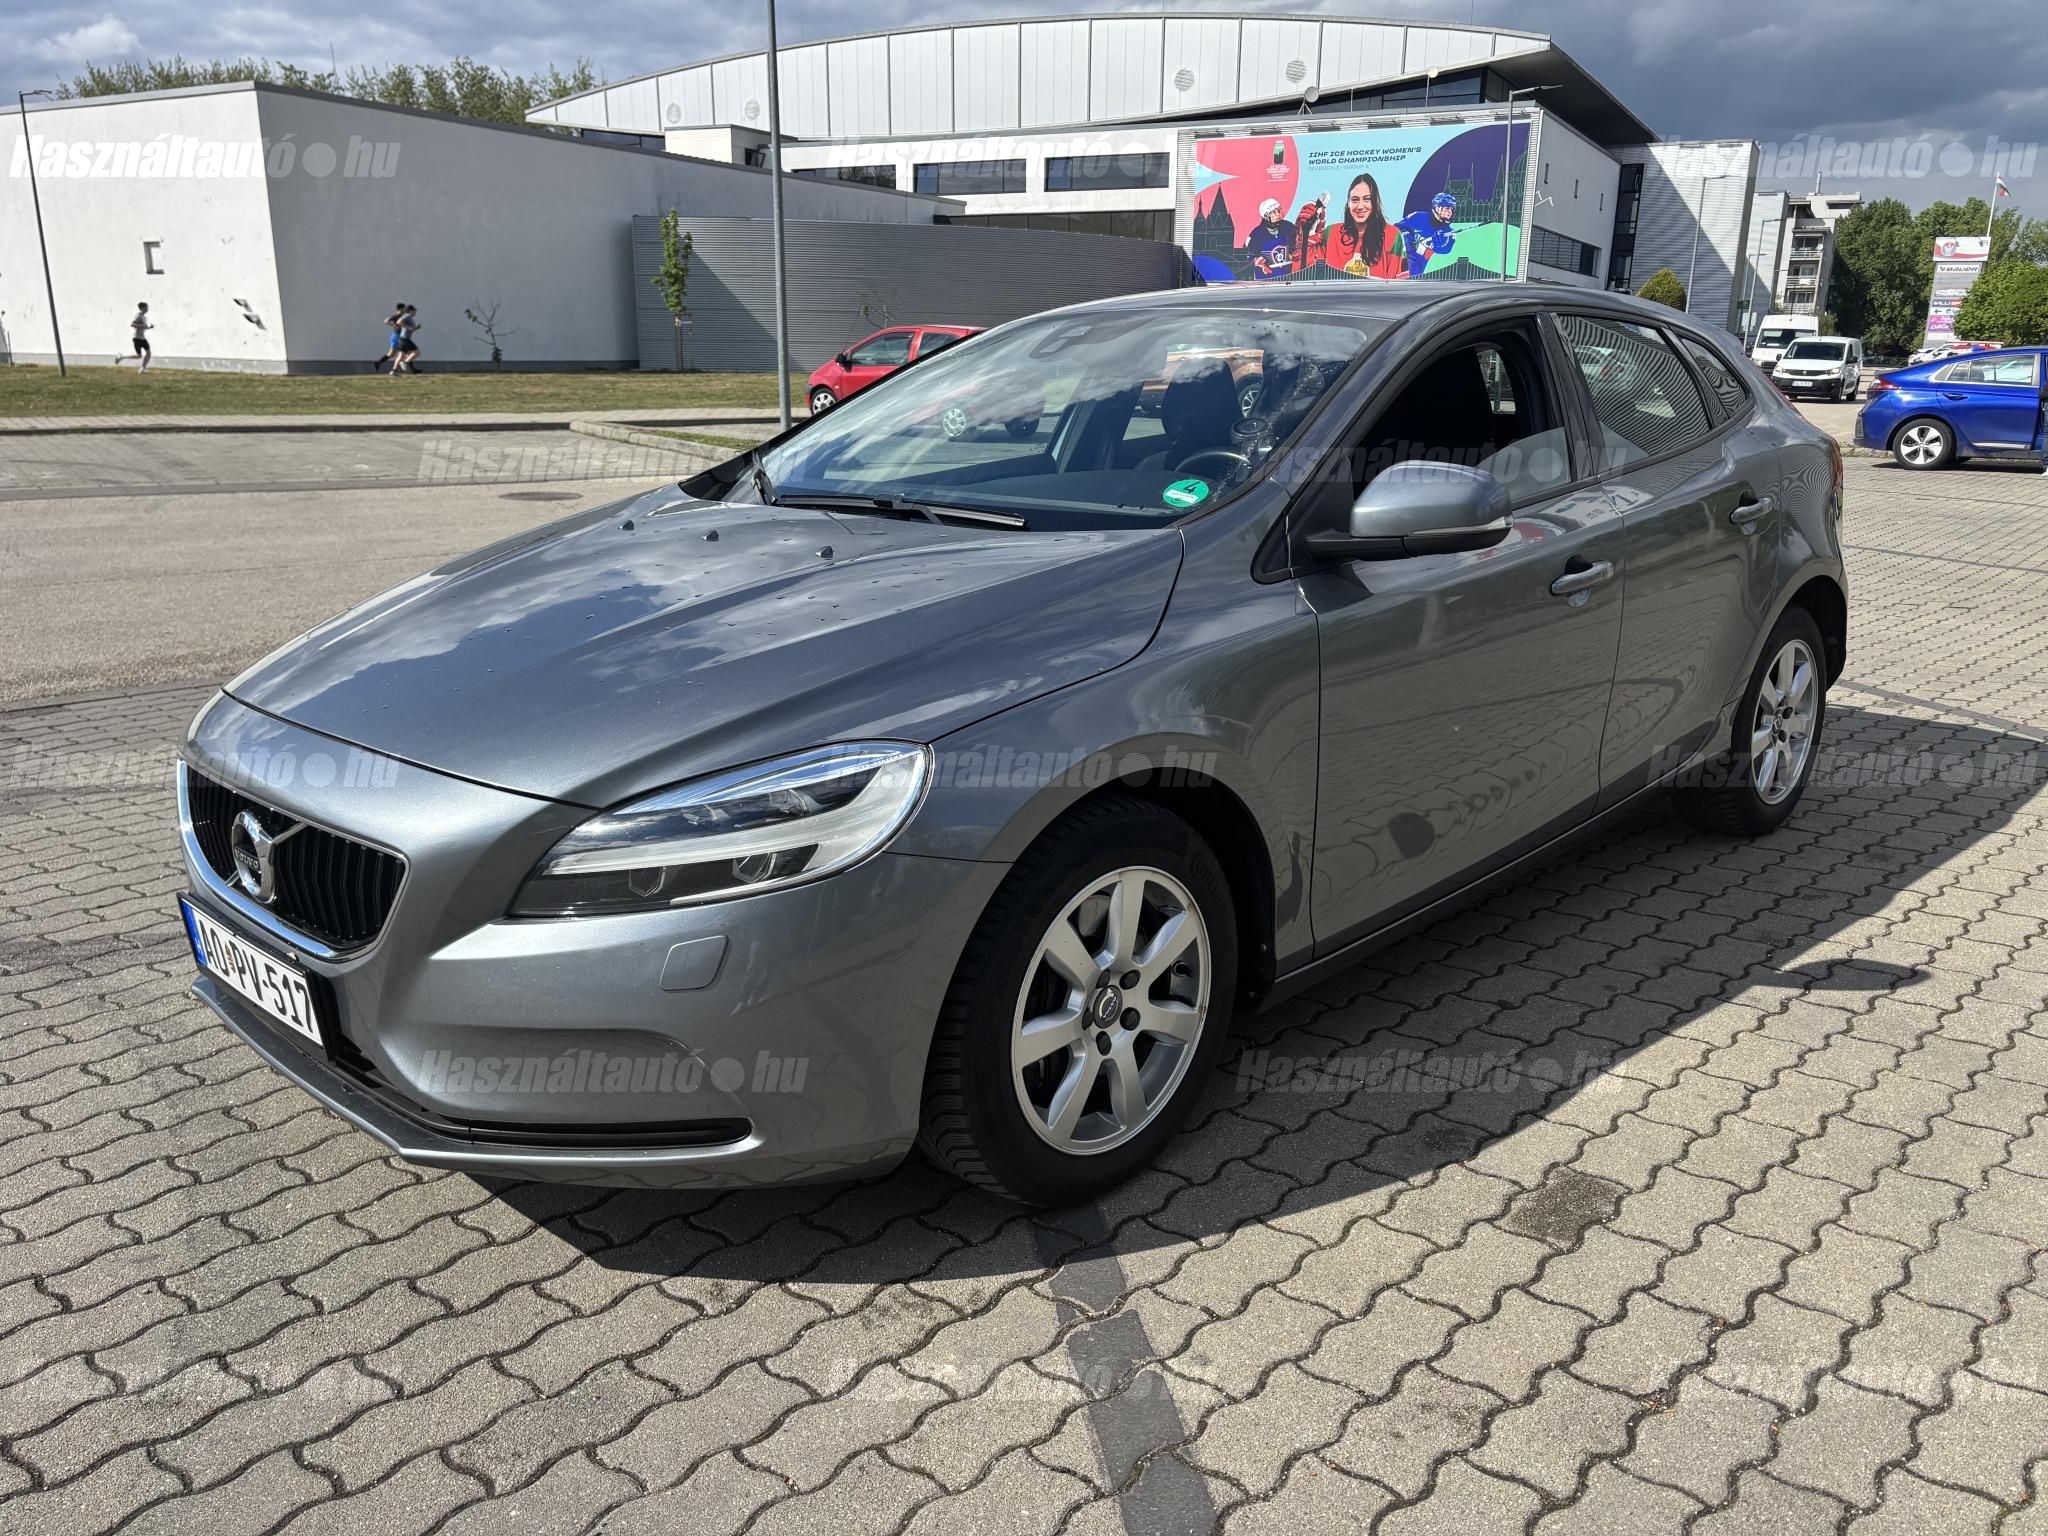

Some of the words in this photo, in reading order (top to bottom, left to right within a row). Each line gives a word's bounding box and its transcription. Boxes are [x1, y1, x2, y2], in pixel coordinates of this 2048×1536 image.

[1346, 148, 1381, 156] HOCKEY
[1382, 146, 1422, 155] WOMEN'S
[1309, 157, 1337, 165] WORLD
[1338, 155, 1406, 164] CHAMPIONSHIP
[1183, 481, 1201, 494] 4
[234, 848, 259, 869] VOLVO
